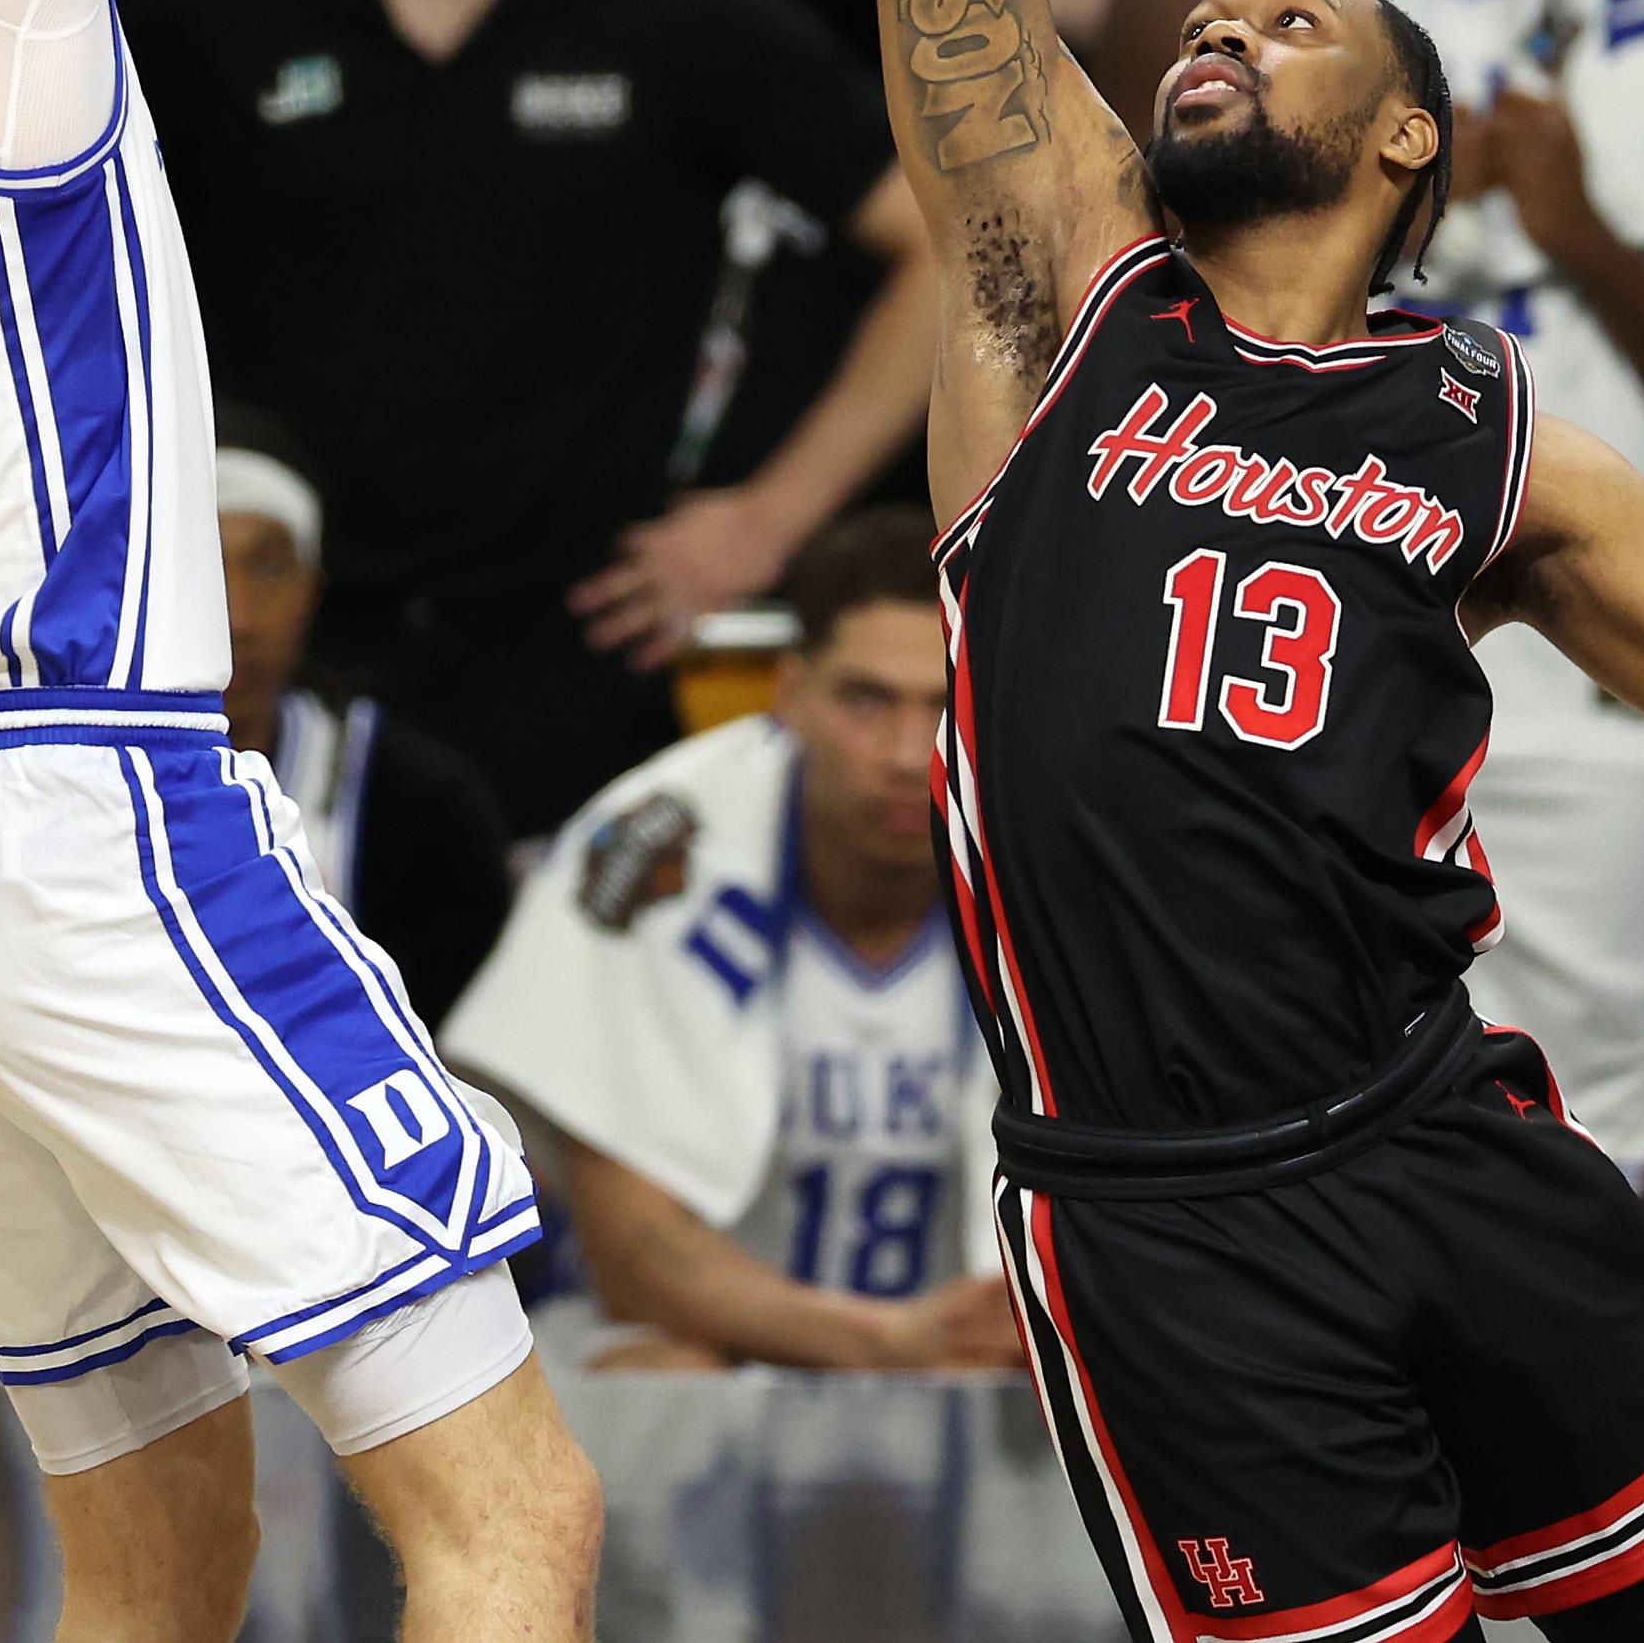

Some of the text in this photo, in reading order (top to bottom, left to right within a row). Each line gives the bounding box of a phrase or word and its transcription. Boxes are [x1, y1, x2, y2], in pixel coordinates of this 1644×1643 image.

[1446, 332, 1497, 370] FINAL FOUR
[1087, 383, 1464, 575] Houston
[1158, 548, 1342, 751] 13
[345, 1068, 450, 1171] D
[789, 1166, 937, 1299] 18
[1178, 1538, 1265, 1607] UH
